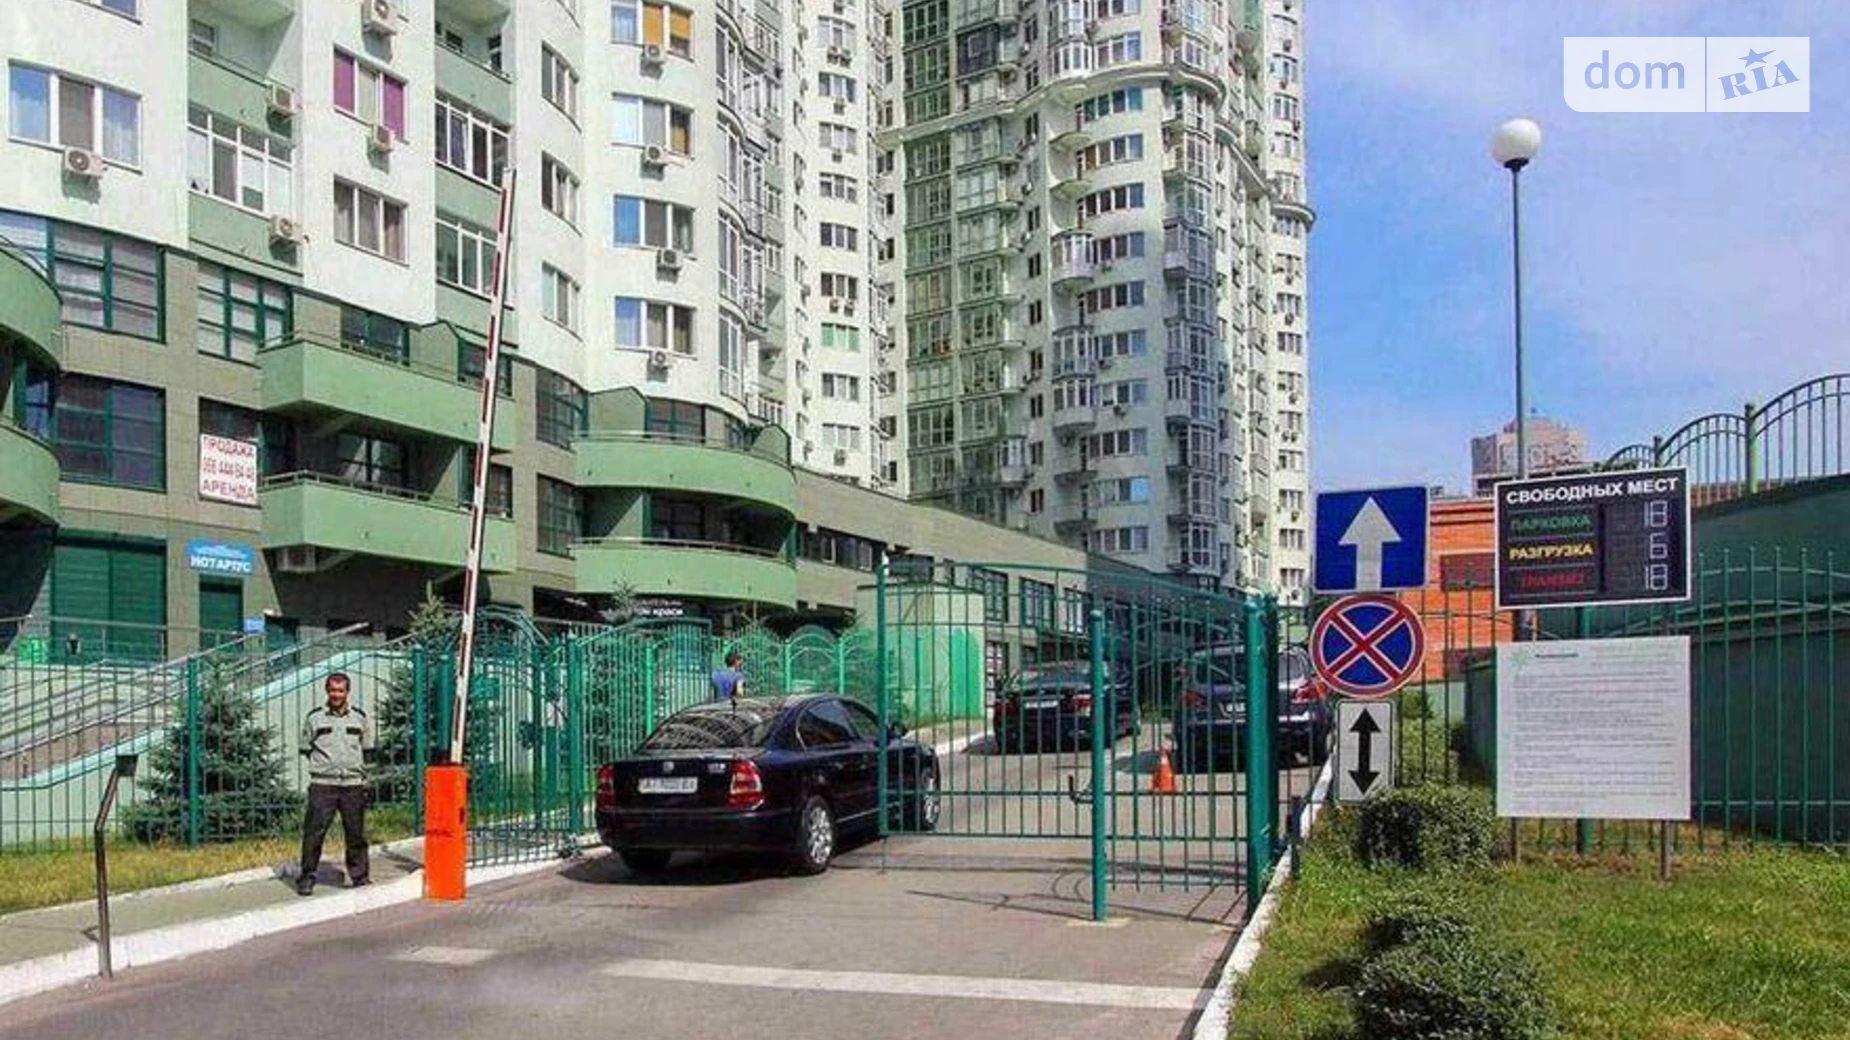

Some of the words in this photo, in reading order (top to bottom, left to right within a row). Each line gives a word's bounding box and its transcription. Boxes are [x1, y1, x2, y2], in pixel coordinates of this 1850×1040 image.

[203, 436, 255, 457] ПРОДАЖА
[203, 479, 255, 499] АРЕНДА
[1506, 482, 1624, 504] СВОБОДНЫХ
[1627, 477, 1679, 495] МЕСТ
[1511, 514, 1592, 531] ПАРКОВКА
[1509, 543, 1594, 561] РАЗГРУЗКА
[1650, 532, 1668, 559] 6
